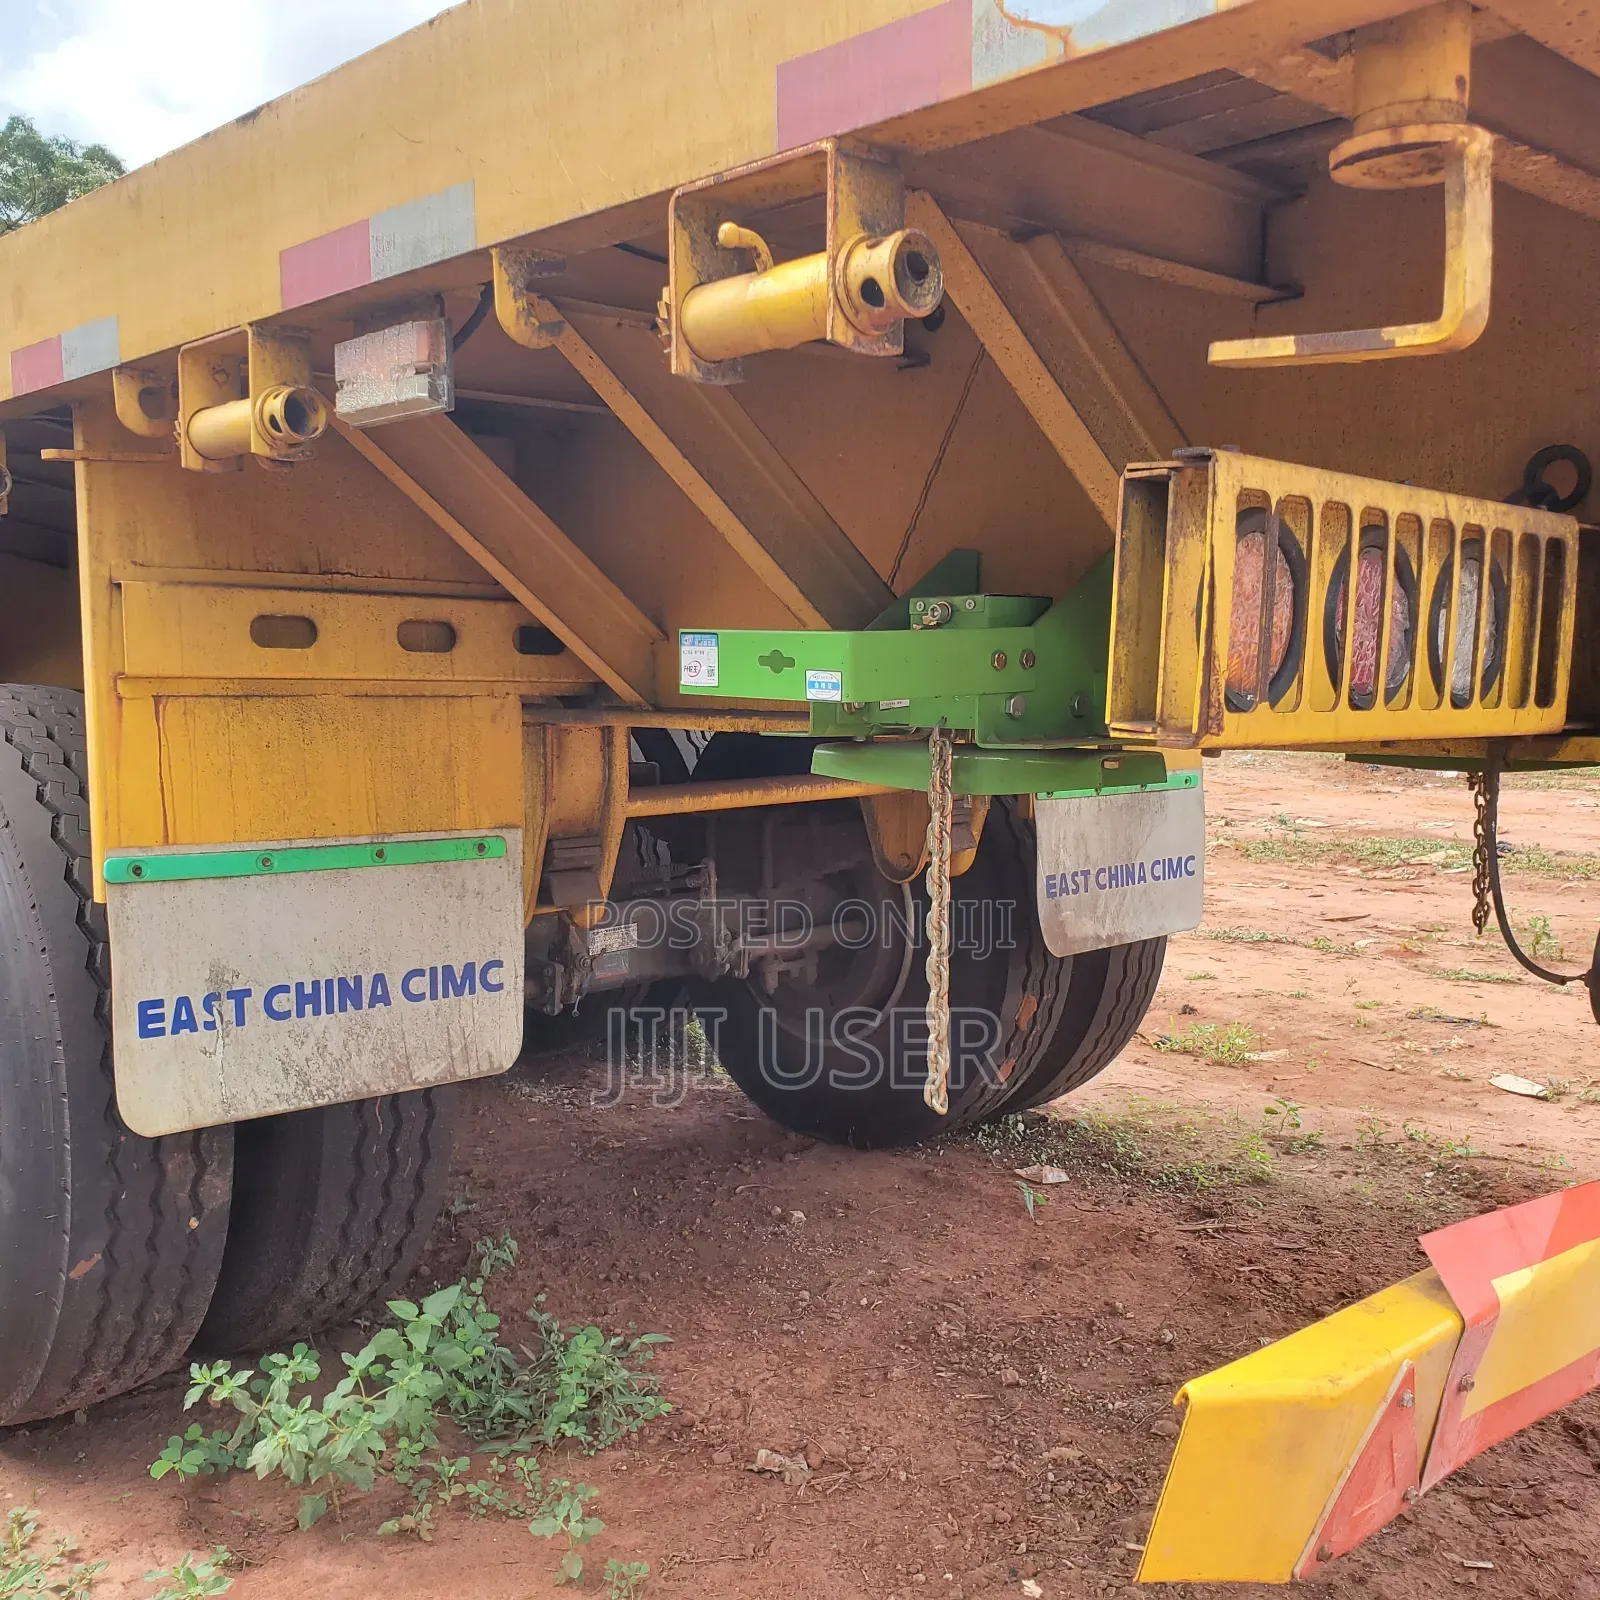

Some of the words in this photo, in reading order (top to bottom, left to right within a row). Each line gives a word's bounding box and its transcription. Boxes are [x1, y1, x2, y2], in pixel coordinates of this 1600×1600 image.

[1045, 869, 1091, 899] EAST
[1095, 861, 1147, 891] CHINA
[1150, 855, 1196, 882] CIMC
[137, 988, 252, 1040] EAST
[262, 972, 392, 1022] CHINA
[401, 959, 504, 1004] CIMC
